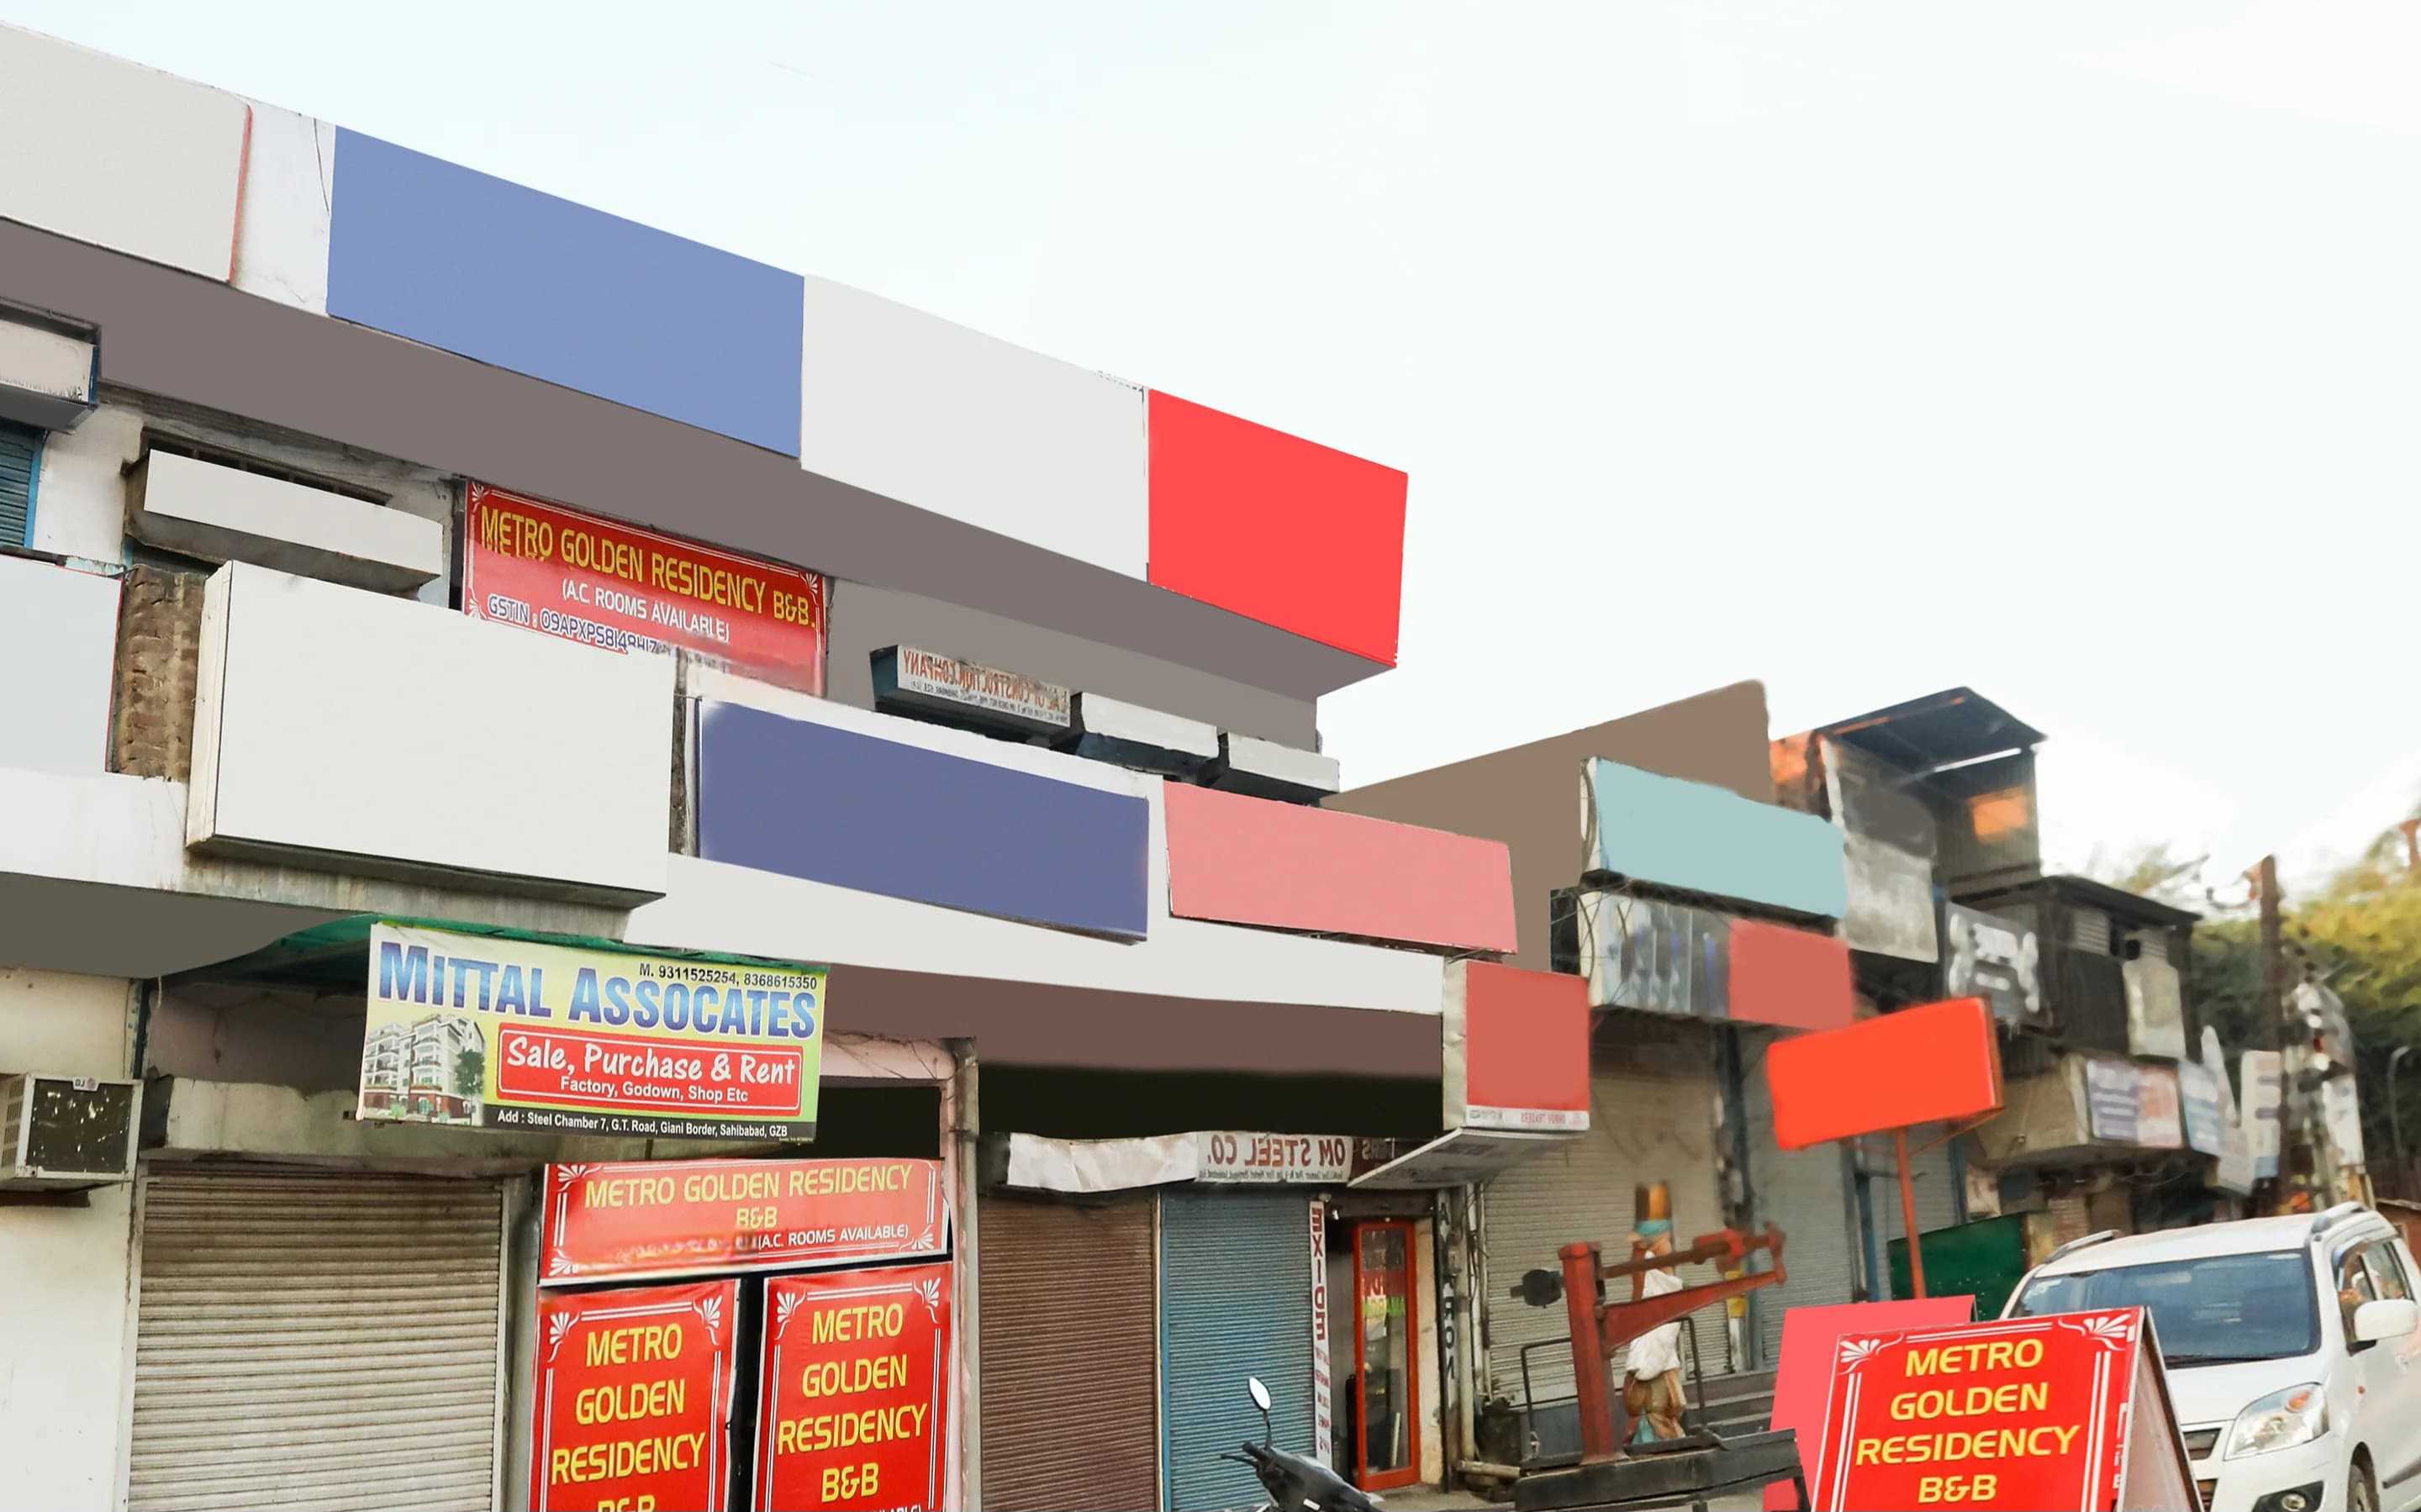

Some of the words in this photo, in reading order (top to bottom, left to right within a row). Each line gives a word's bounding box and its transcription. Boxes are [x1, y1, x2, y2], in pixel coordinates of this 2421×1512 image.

[481, 505, 553, 558] METRO
[561, 528, 643, 582] GOLDEN
[651, 556, 766, 614] RESIDENCY
[773, 591, 815, 628] B&B.
[488, 595, 529, 624] GSTIN
[595, 587, 647, 619] ROOMS
[379, 940, 552, 1018] MITTAL
[568, 967, 816, 1039] ASSOCATES
[640, 962, 654, 977] M.
[659, 965, 740, 987] 9311525254,
[744, 972, 817, 990] 8368615350
[507, 1036, 576, 1076] Sale,
[584, 1042, 703, 1081] Purchase
[710, 1053, 731, 1082] &
[740, 1054, 795, 1084] Rent
[561, 1076, 619, 1098] Factory,
[622, 1081, 684, 1101] Godown,
[688, 1086, 723, 1104] Shop
[727, 1088, 748, 1103] Etc
[498, 1109, 519, 1124] Add
[527, 1113, 552, 1126] Steel
[554, 1114, 599, 1130] Chamber
[600, 1118, 609, 1132] 7,
[611, 1120, 630, 1131] G.T.
[632, 1120, 658, 1135] Road,
[686, 1122, 718, 1137] Border,
[720, 1124, 767, 1138] Sahibabad,
[769, 1125, 788, 1137] GZB
[585, 1174, 675, 1209] METRO
[684, 1170, 780, 1203] GOLDEN
[789, 1164, 913, 1198] RESIDENCY
[736, 1206, 778, 1229] B&B
[758, 1233, 783, 1250] (A.C.
[788, 1229, 836, 1246] ROOMS
[840, 1223, 909, 1241] AVAILABLE)
[586, 1322, 683, 1367] METRO
[811, 1303, 905, 1345] METRO
[802, 1354, 907, 1398] GOLDEN
[1904, 1338, 2044, 1378] METRO
[575, 1379, 685, 1425] GOLDEN
[1890, 1382, 2049, 1421] GOLDEN
[777, 1403, 928, 1455] RESIDENCY
[1855, 1425, 2081, 1467] RESIDENCY
[551, 1432, 706, 1486] RESIDENCY
[820, 1462, 879, 1502] B&B
[1917, 1473, 1997, 1504] B&B
